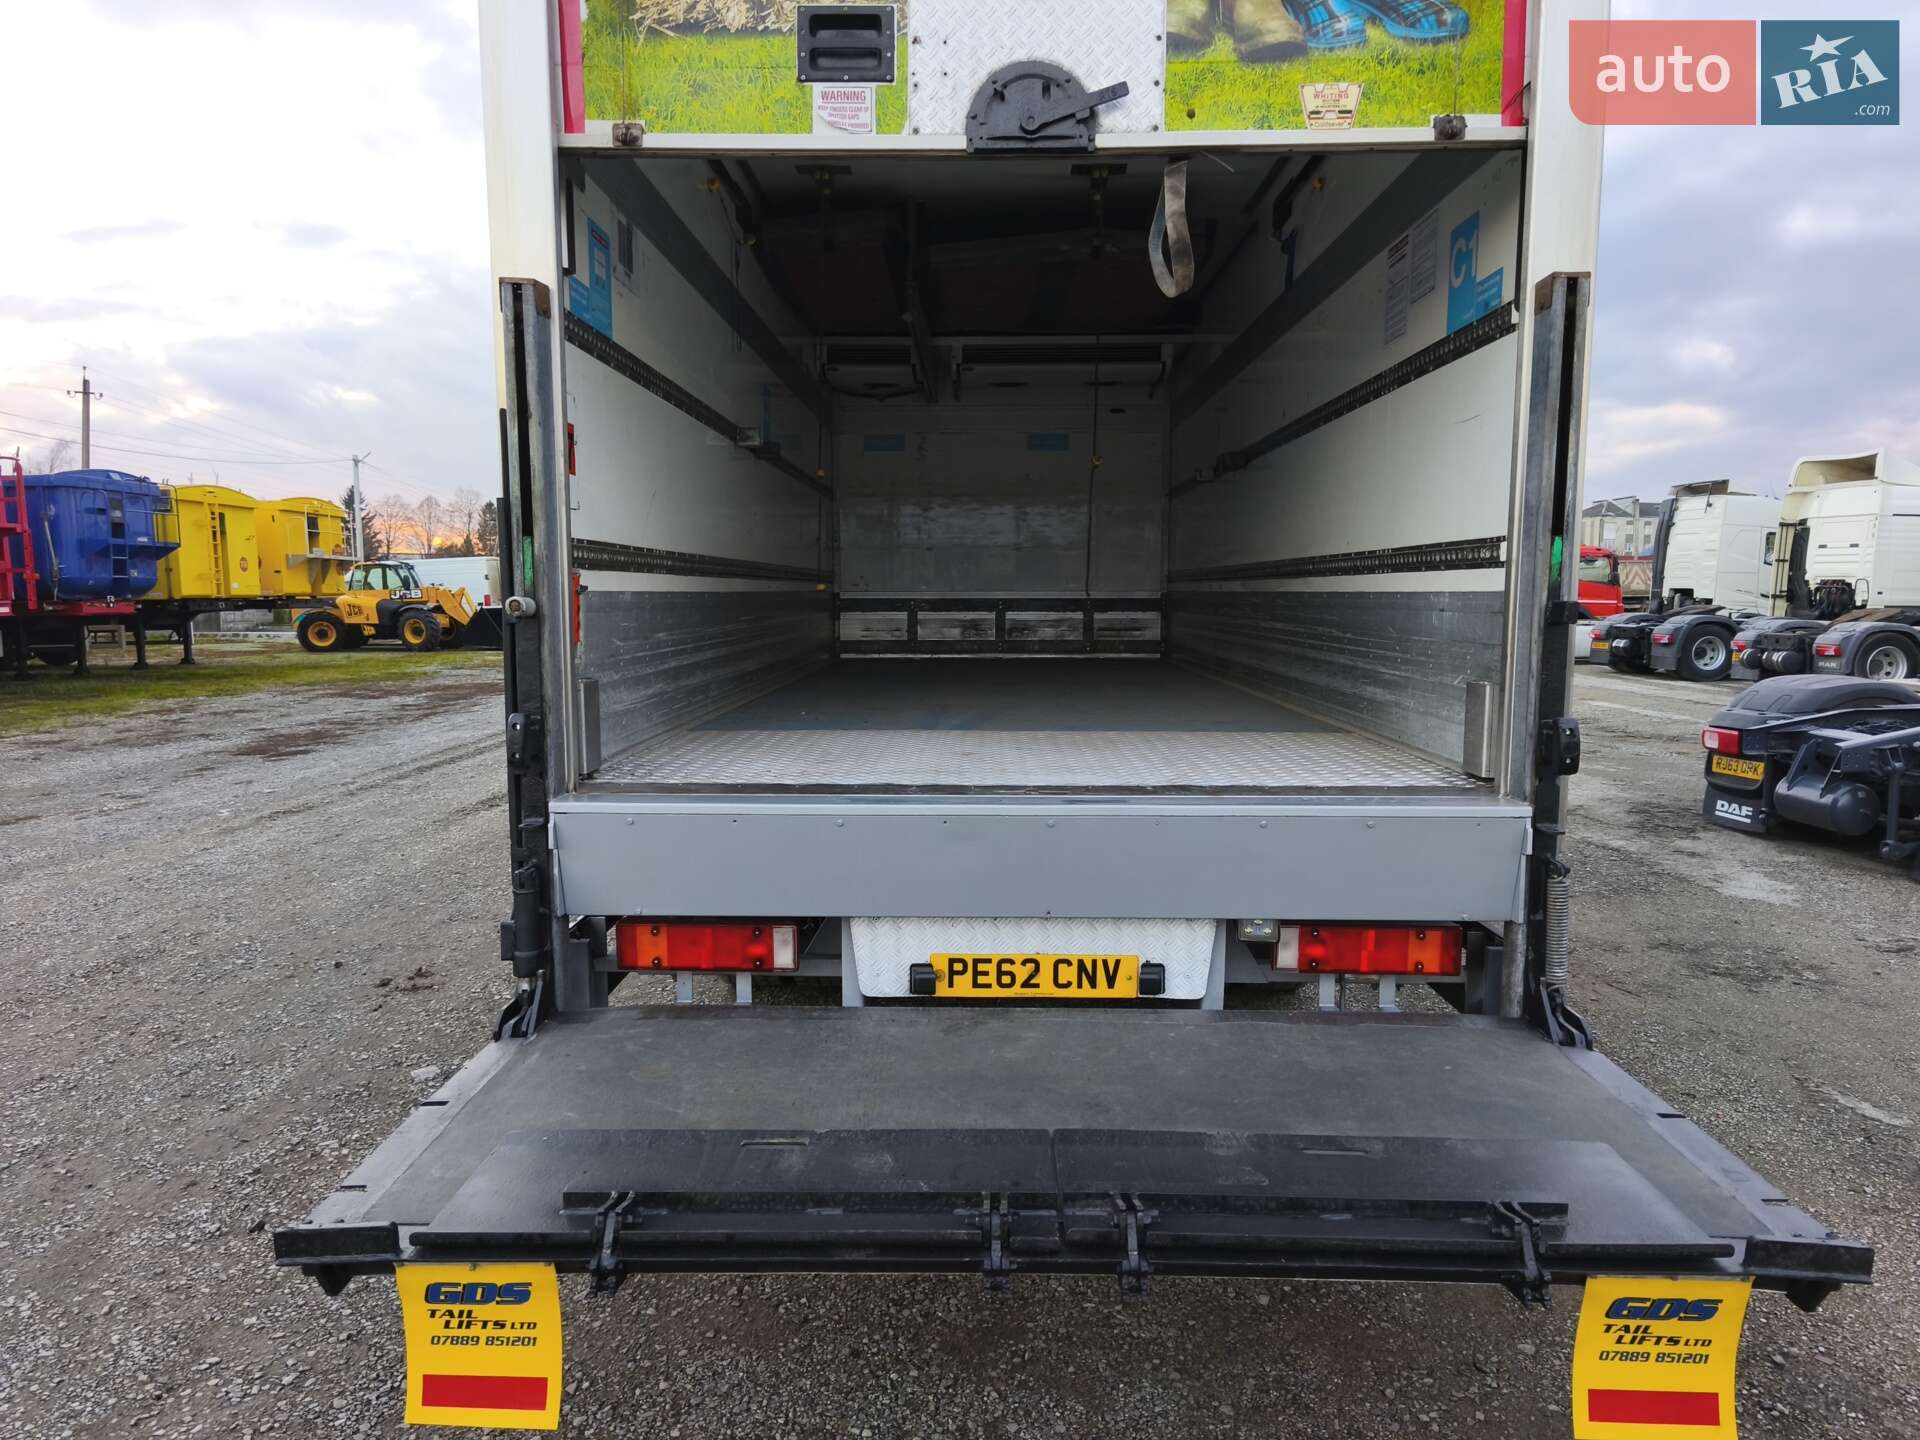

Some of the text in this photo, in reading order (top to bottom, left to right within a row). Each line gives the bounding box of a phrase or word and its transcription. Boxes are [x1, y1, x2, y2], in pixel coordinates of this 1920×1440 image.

[820, 89, 866, 101] WARNING
[390, 590, 423, 599] JCB
[1715, 799, 1753, 817] DAF
[947, 957, 1121, 989] PE62 CNV
[424, 1282, 532, 1306] GDS
[427, 1308, 479, 1319] TAIL
[1604, 1296, 1723, 1322] GDS
[443, 1319, 538, 1330] LIFTS LTD
[1603, 1323, 1654, 1335] TAIL
[430, 1335, 538, 1347] 07889 851201
[1614, 1334, 1713, 1347] LIFTS LTD
[1598, 1350, 1710, 1365] 07889 851201
